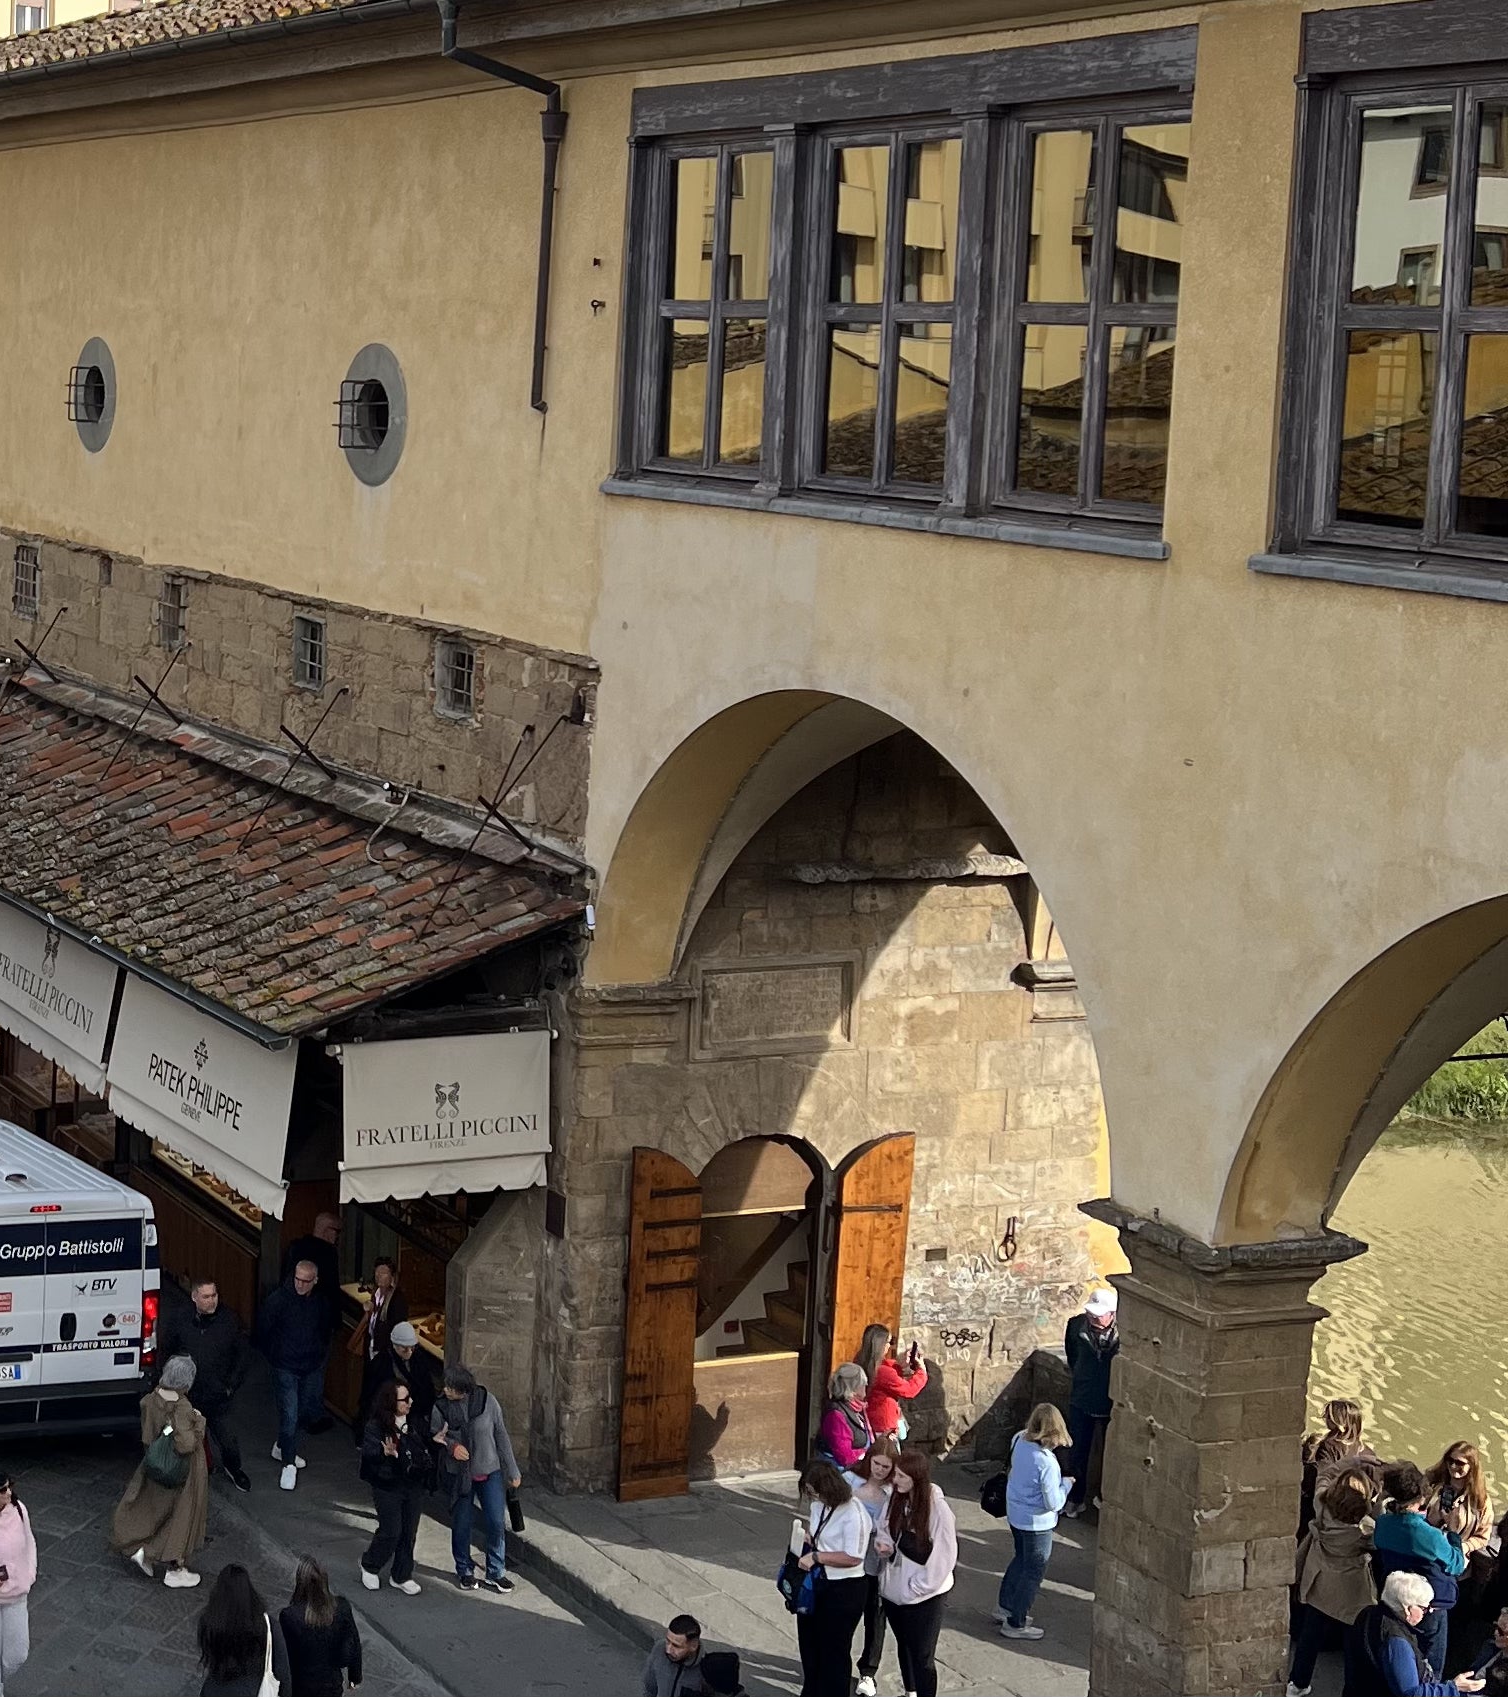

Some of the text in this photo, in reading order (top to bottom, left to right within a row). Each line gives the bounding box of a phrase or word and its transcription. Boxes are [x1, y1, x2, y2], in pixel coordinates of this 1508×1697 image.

[47, 985, 94, 1035] PICCINI
[147, 1053, 243, 1131] PATEK PHILIPPE
[356, 1114, 538, 1147] FRATELLI PICCINI
[429, 1139, 467, 1150] FIRENZE
[0, 1237, 125, 1261] Gruppo Battistolli
[91, 1278, 117, 1291] BTV
[122, 1314, 136, 1323] 640
[52, 1339, 129, 1352] TRASPORTO VALORI
